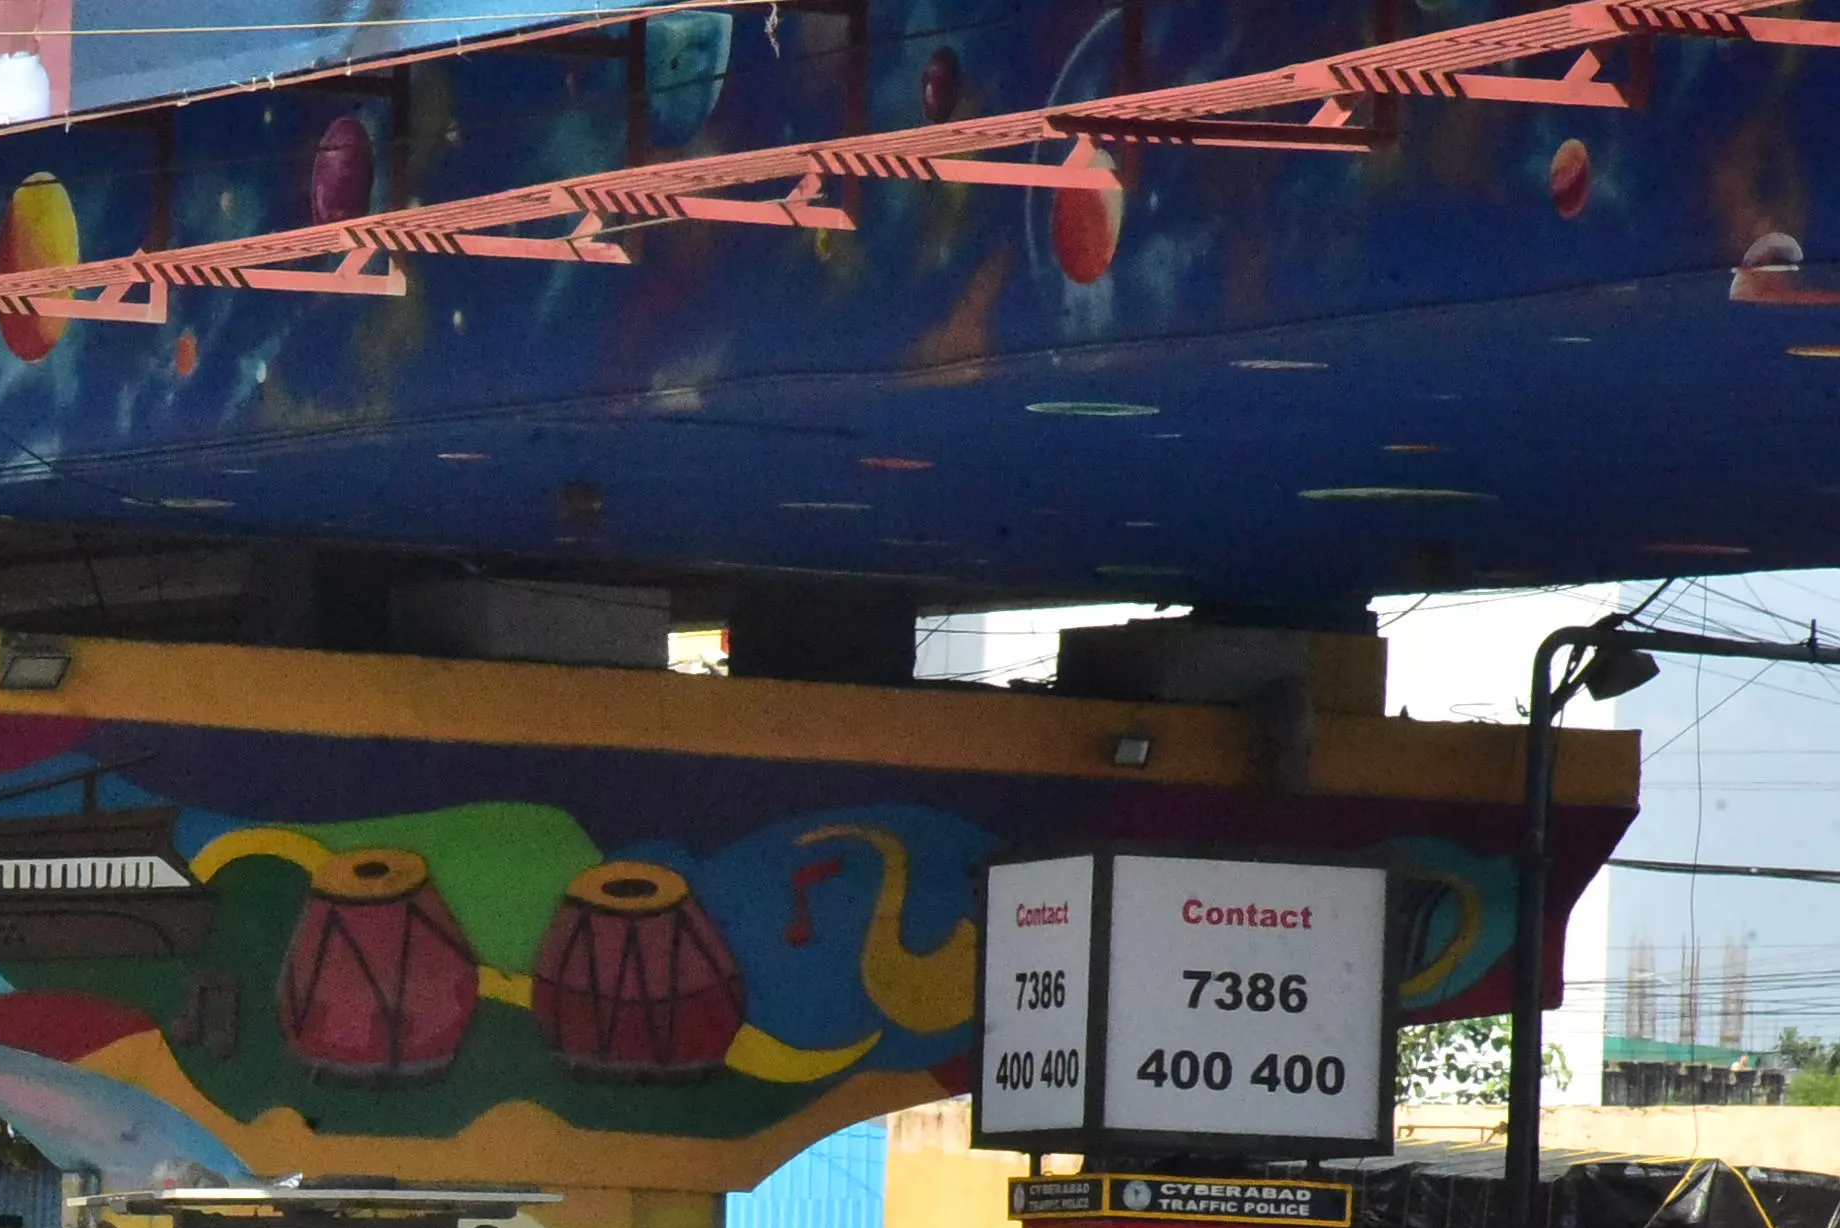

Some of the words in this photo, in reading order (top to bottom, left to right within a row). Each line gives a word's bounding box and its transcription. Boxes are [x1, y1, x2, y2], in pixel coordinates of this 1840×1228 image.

[1016, 902, 1069, 928] Contact
[1181, 899, 1313, 930] Contact
[1015, 970, 1066, 1010] 7386
[1182, 970, 1309, 1014] 7386
[996, 1052, 1034, 1090] 400
[1040, 1049, 1079, 1088] 400
[1136, 1049, 1233, 1091] 400
[1250, 1053, 1346, 1096] 400
[1159, 1199, 1237, 1214] TRAFFIC
[1244, 1201, 1311, 1217] POLICE
[1160, 1183, 1313, 1201] CYBERABAD
